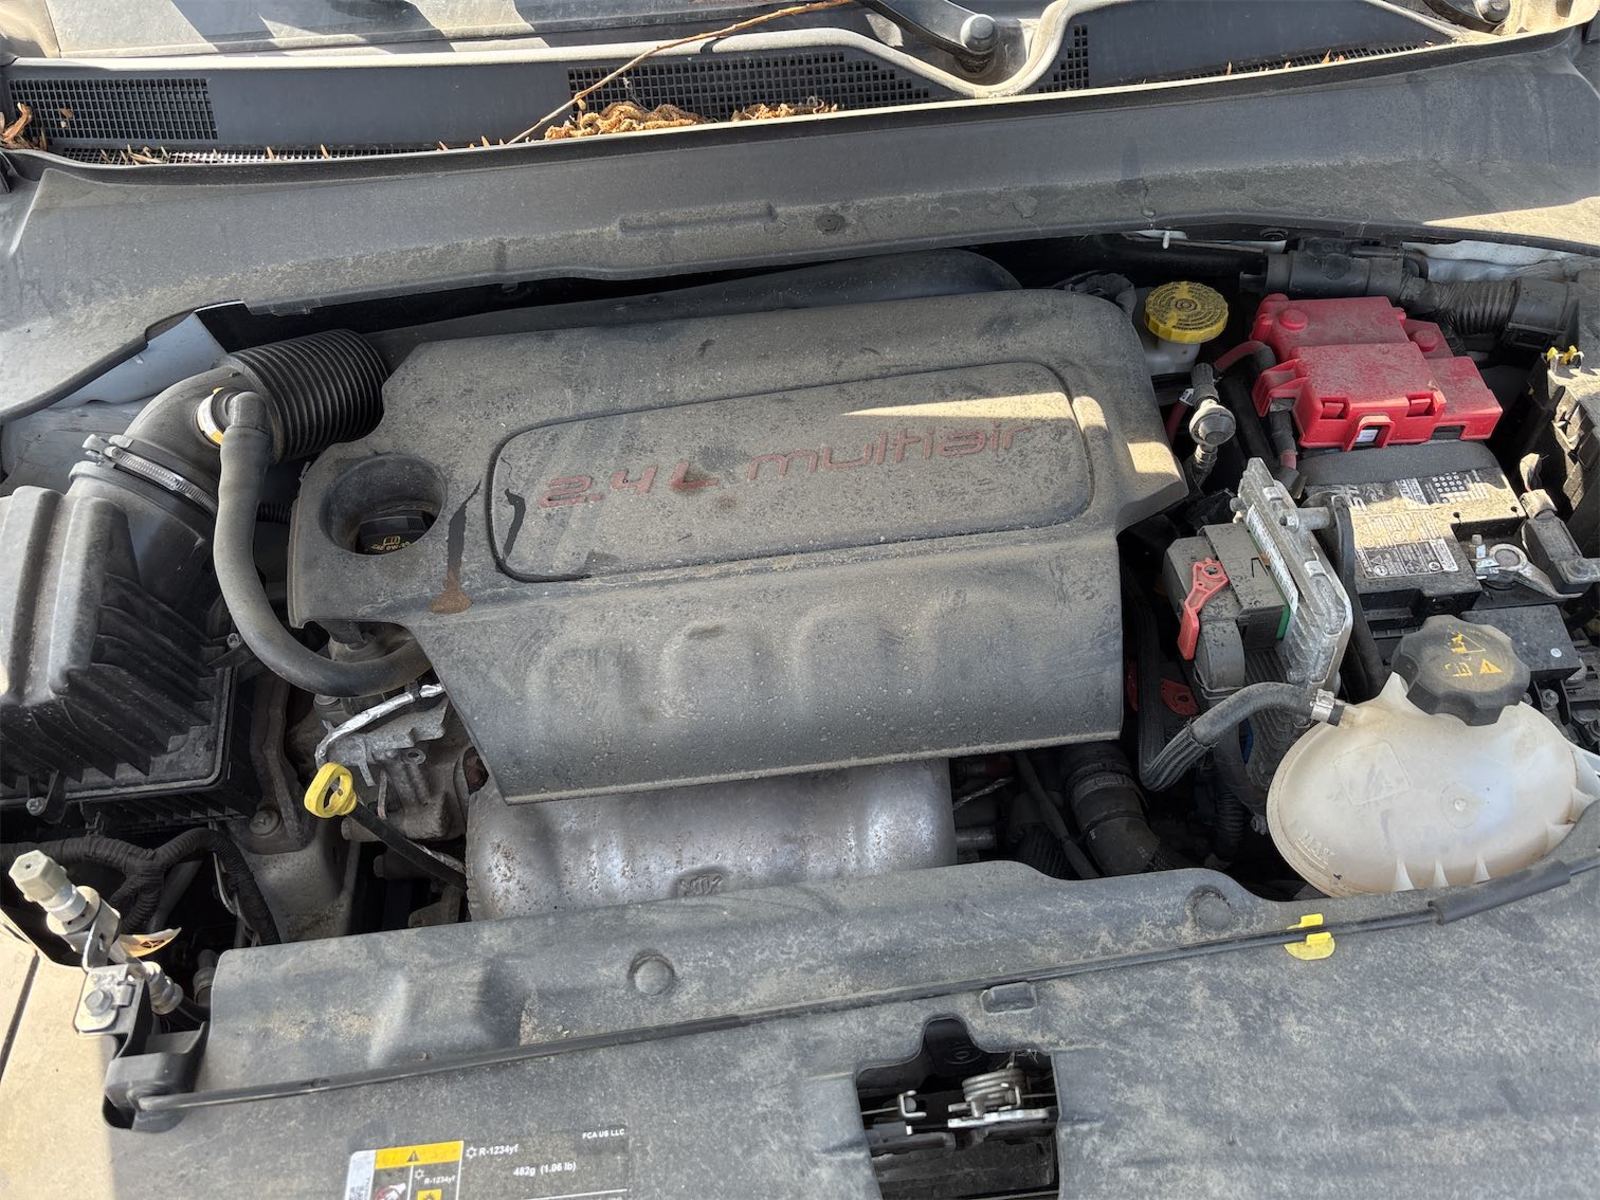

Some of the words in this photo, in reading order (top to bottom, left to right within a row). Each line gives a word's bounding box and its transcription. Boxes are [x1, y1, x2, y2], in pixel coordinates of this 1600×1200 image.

[747, 420, 1031, 480] multiair
[582, 1131, 597, 1139] FCA
[611, 1128, 625, 1136] LLC
[479, 1144, 519, 1156] R-1234yf
